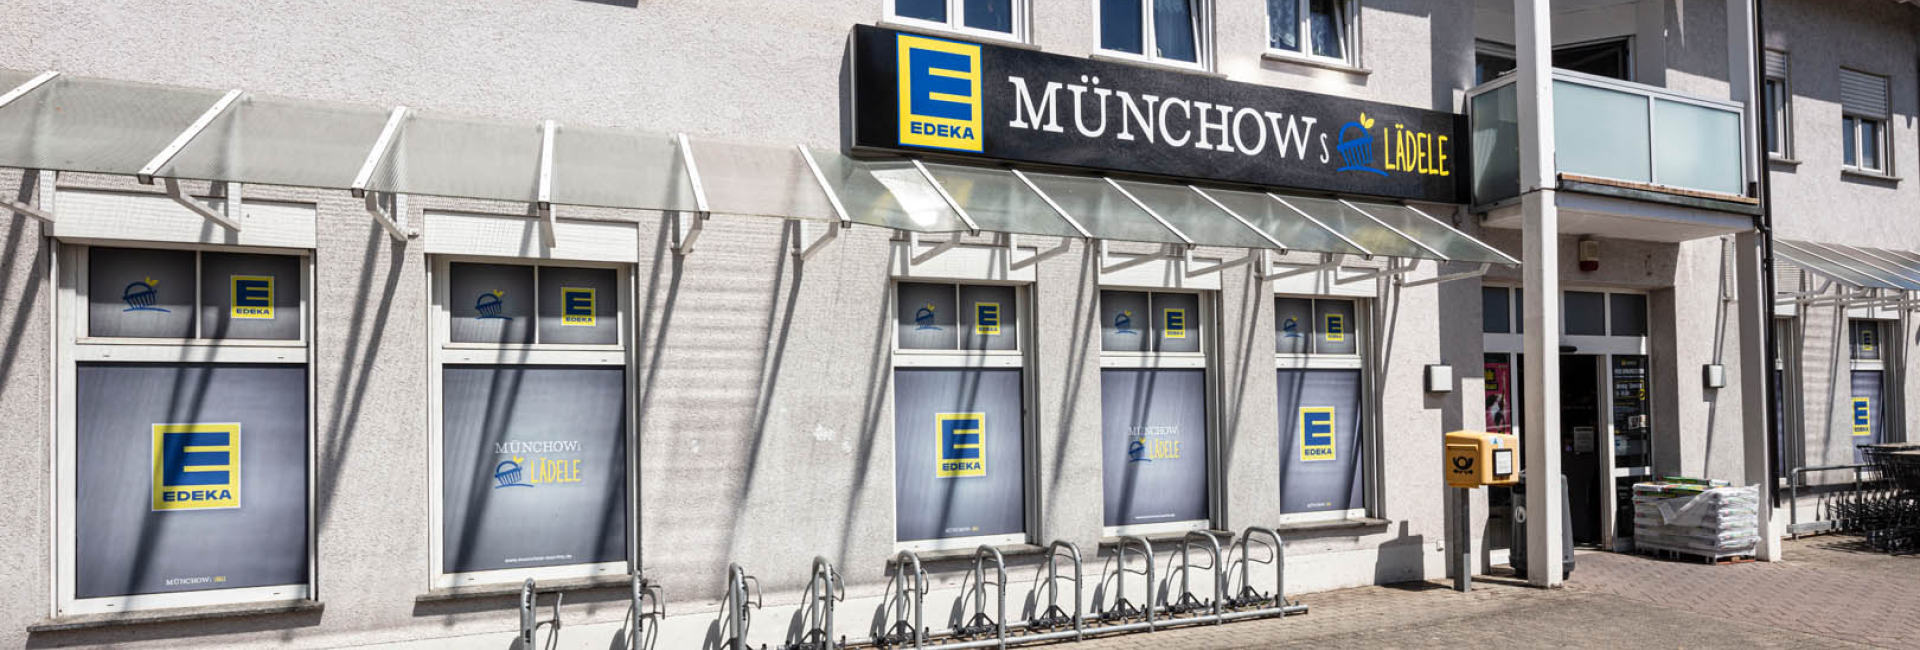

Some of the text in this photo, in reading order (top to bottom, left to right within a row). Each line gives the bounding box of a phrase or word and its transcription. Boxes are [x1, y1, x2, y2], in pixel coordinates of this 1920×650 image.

[910, 121, 975, 140] EDEKA
[1384, 124, 1450, 176] LÄDELE
[530, 457, 582, 484] LÄDELE
[942, 462, 980, 471] EDEKA
[163, 490, 232, 502] EDEKA
